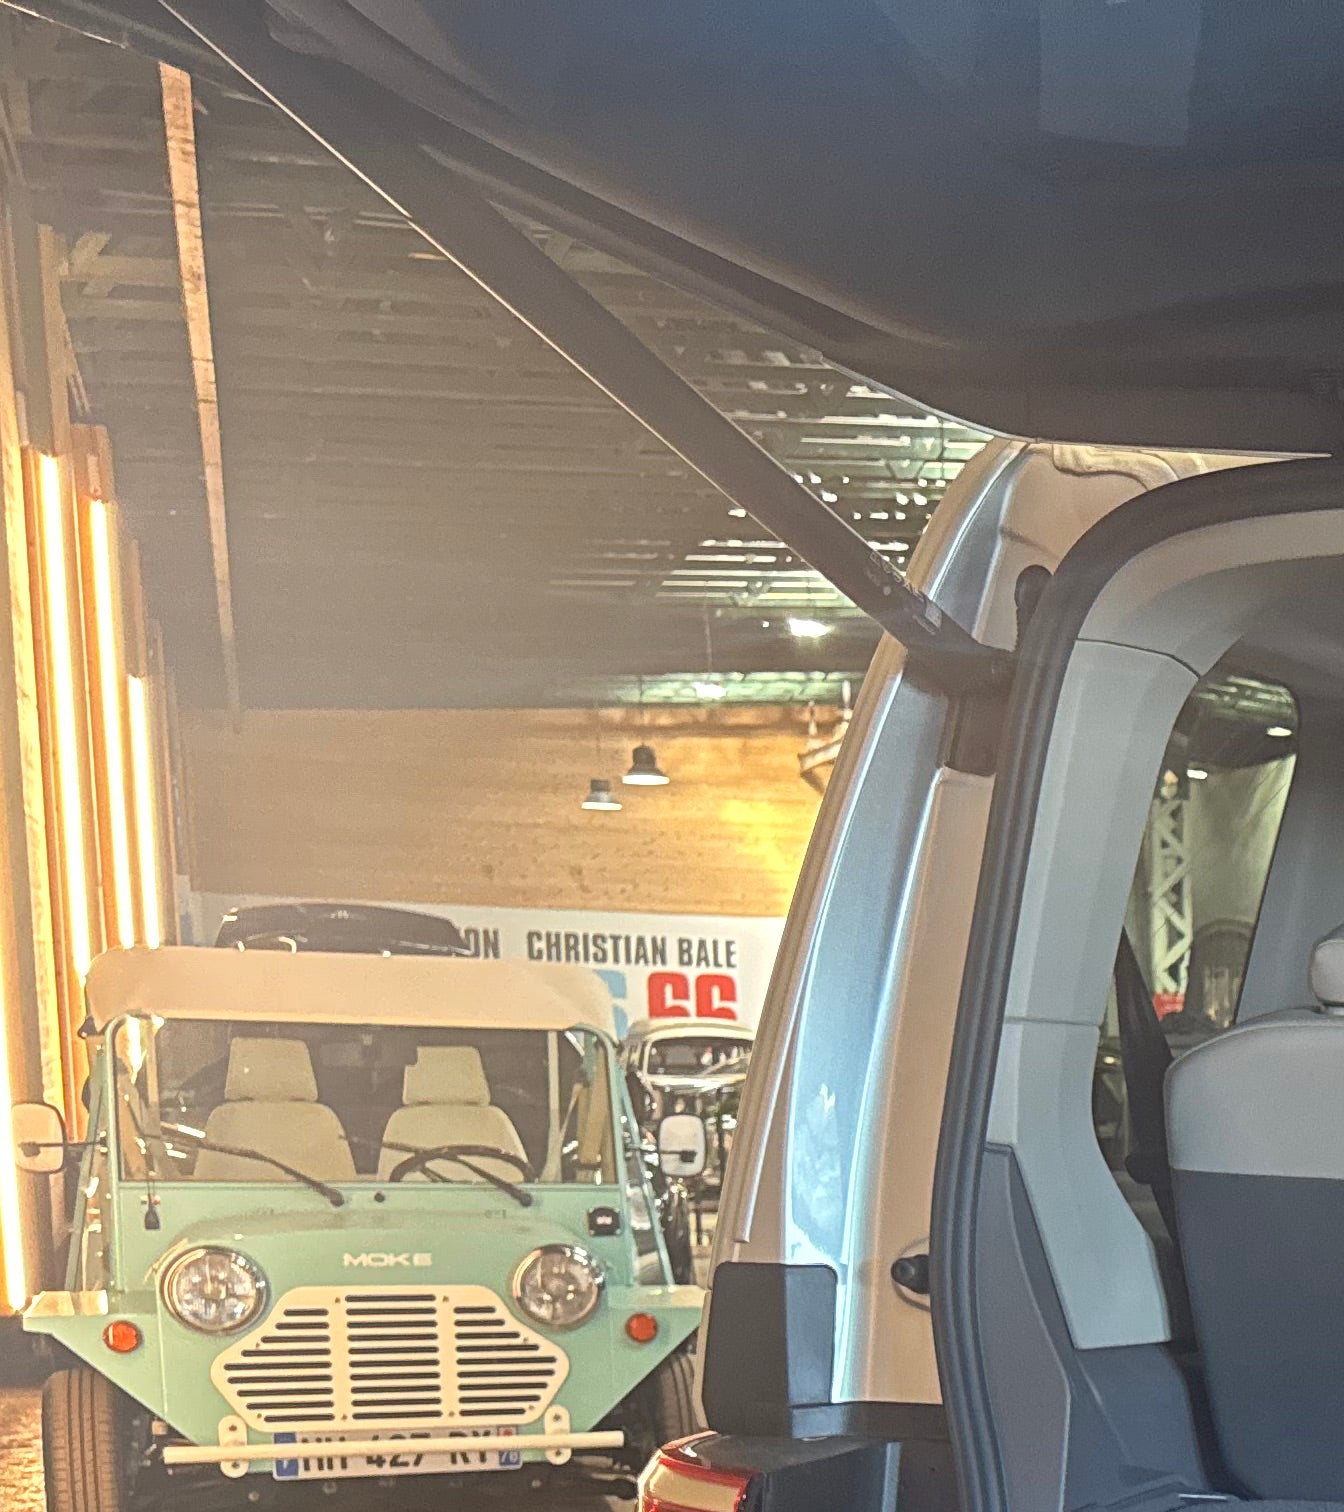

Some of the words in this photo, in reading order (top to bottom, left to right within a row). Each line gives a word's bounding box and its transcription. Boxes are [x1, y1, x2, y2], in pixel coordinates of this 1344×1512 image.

[526, 930, 667, 967] CHRISTIAN
[677, 937, 738, 969] BALE
[343, 1252, 433, 1268] MOKE
